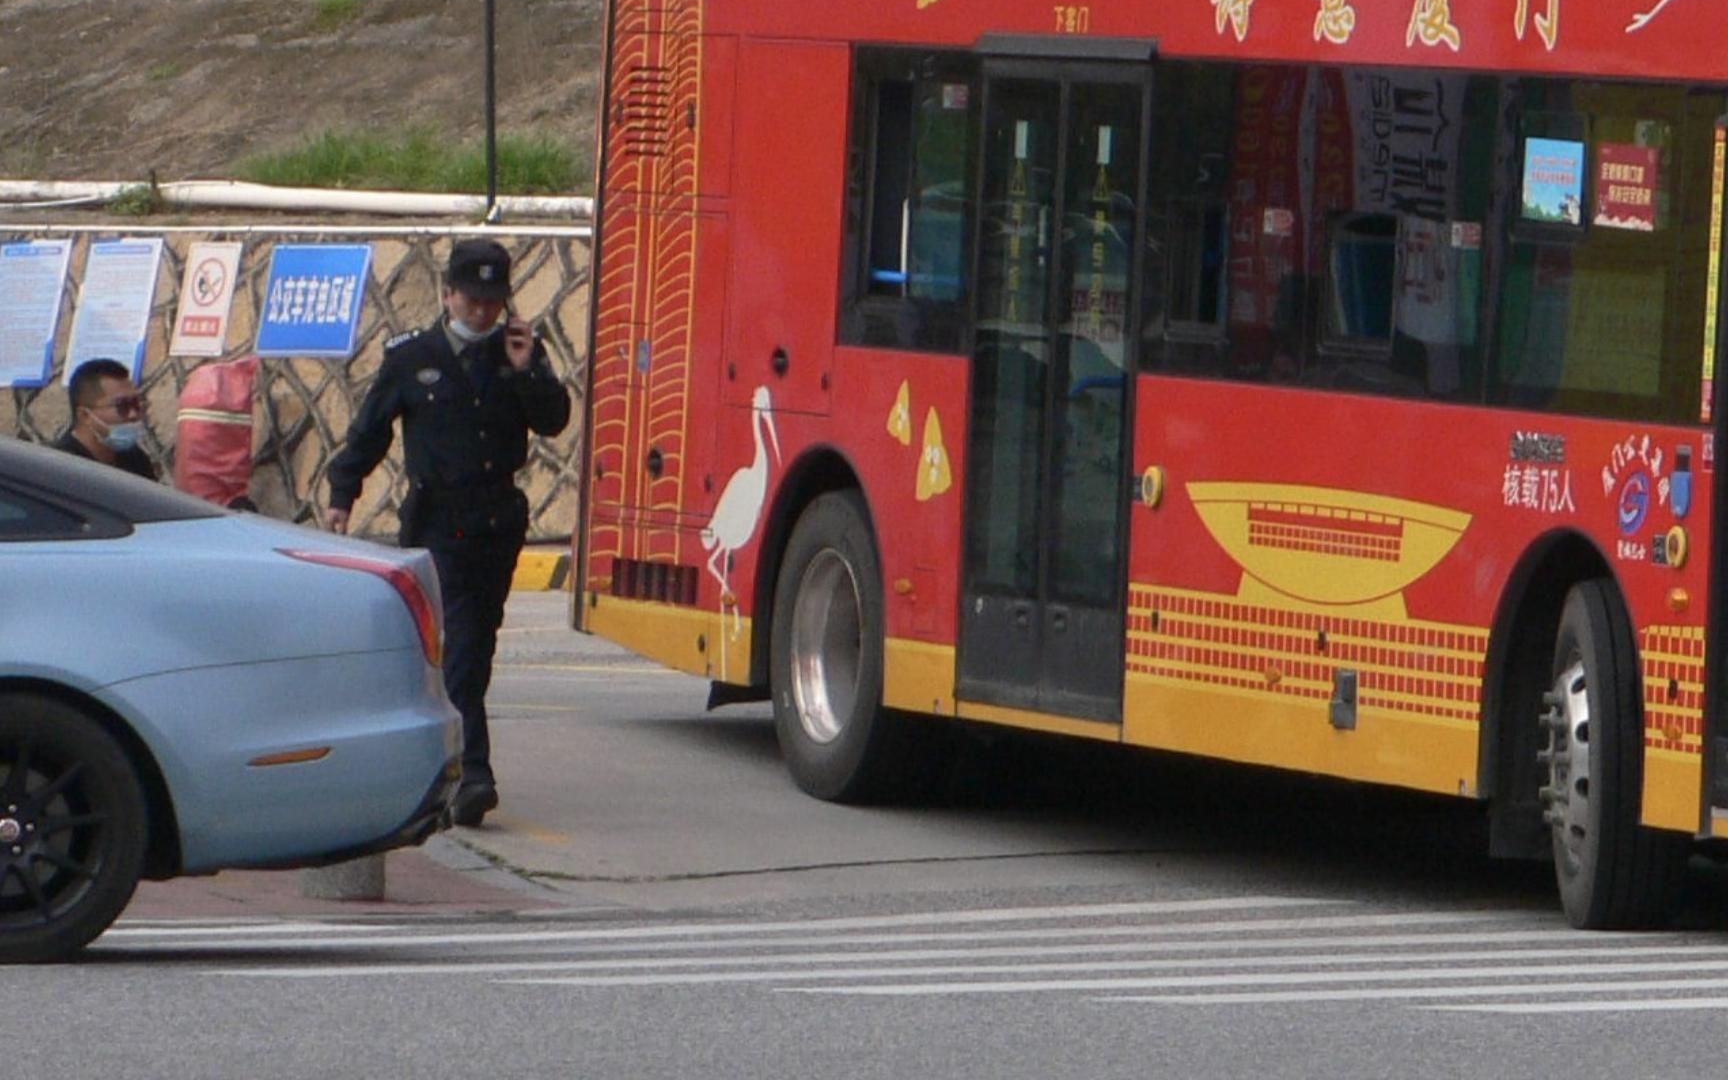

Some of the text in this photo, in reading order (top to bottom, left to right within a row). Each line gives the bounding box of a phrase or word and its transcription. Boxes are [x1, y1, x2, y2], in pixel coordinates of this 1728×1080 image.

[267, 273, 357, 324] 公交车充电区域
[1501, 463, 1576, 513] 核载75人
